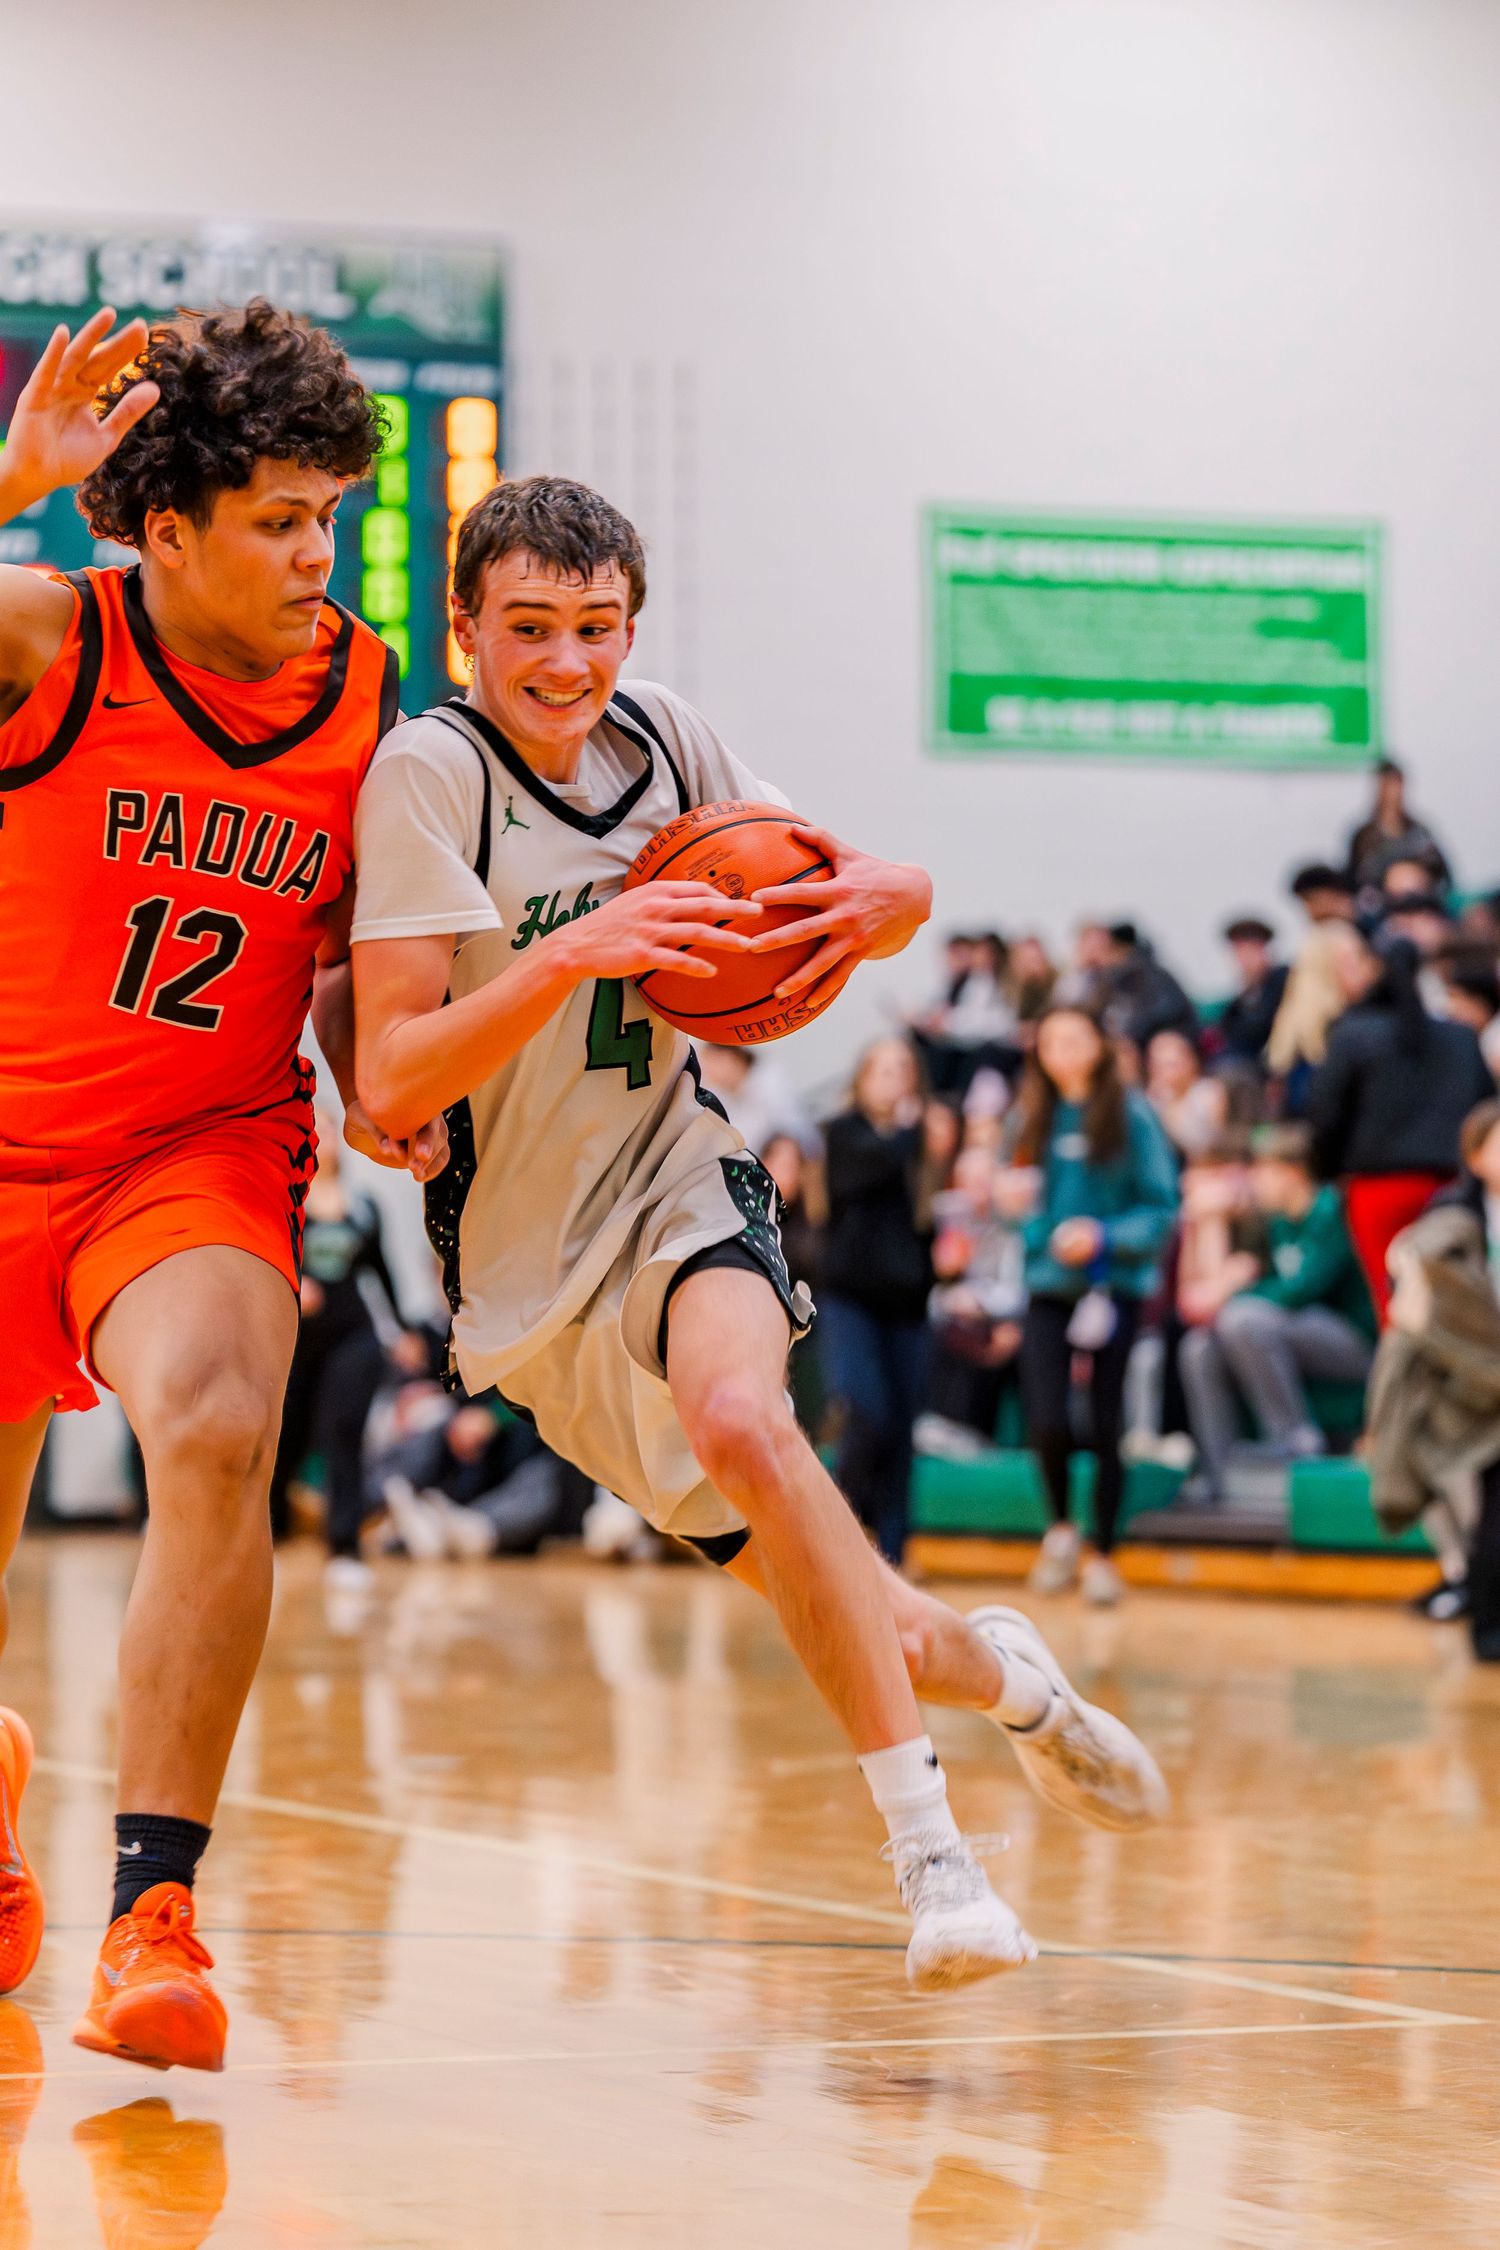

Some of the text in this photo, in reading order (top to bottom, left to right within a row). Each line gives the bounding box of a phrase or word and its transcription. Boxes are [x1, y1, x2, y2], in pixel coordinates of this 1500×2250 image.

[102, 787, 331, 903] PADUA
[107, 894, 249, 1033] 12
[511, 881, 601, 950] Hob
[584, 977, 653, 1092] 4
